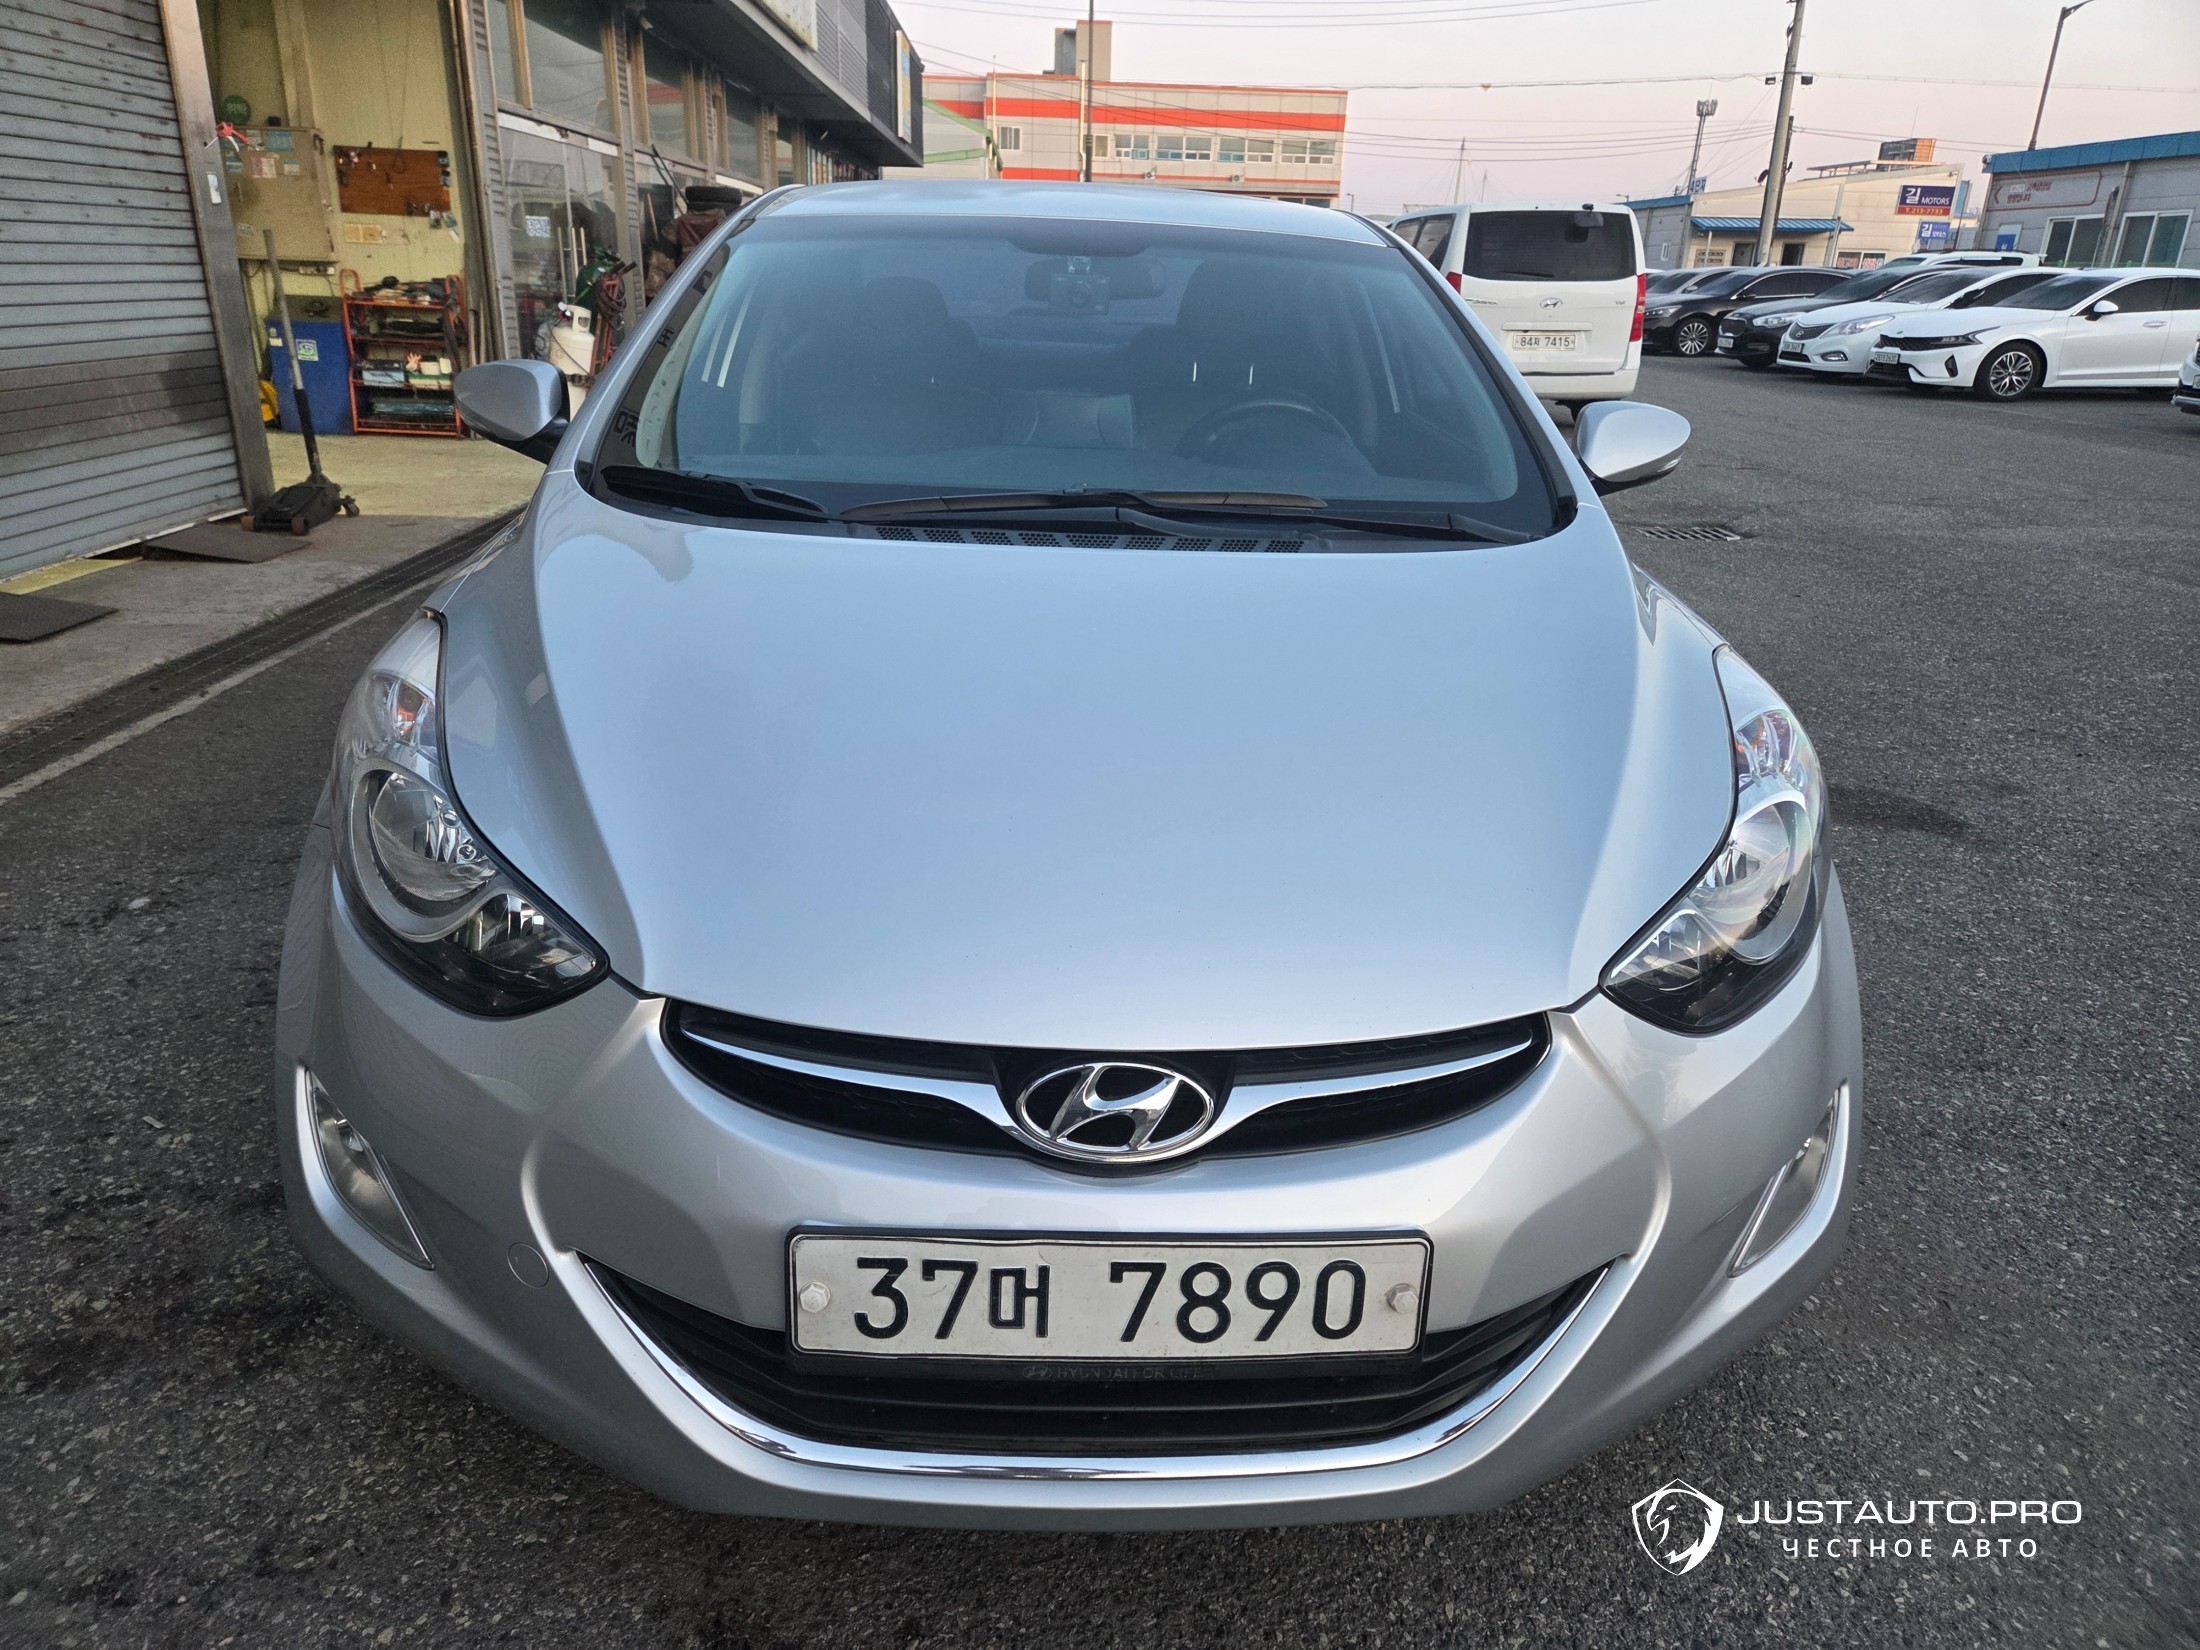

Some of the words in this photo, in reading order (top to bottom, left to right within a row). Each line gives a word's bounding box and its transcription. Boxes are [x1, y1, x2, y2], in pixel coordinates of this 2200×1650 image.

[1905, 187, 1922, 204] 길
[1921, 196, 1950, 205] MOTORS
[1905, 207, 1943, 215] T.213-7733
[1921, 223, 1933, 238] 길
[1544, 336, 1570, 347] 7415
[854, 1258, 1050, 1339] 37머
[1110, 1260, 1365, 1343] 7890
